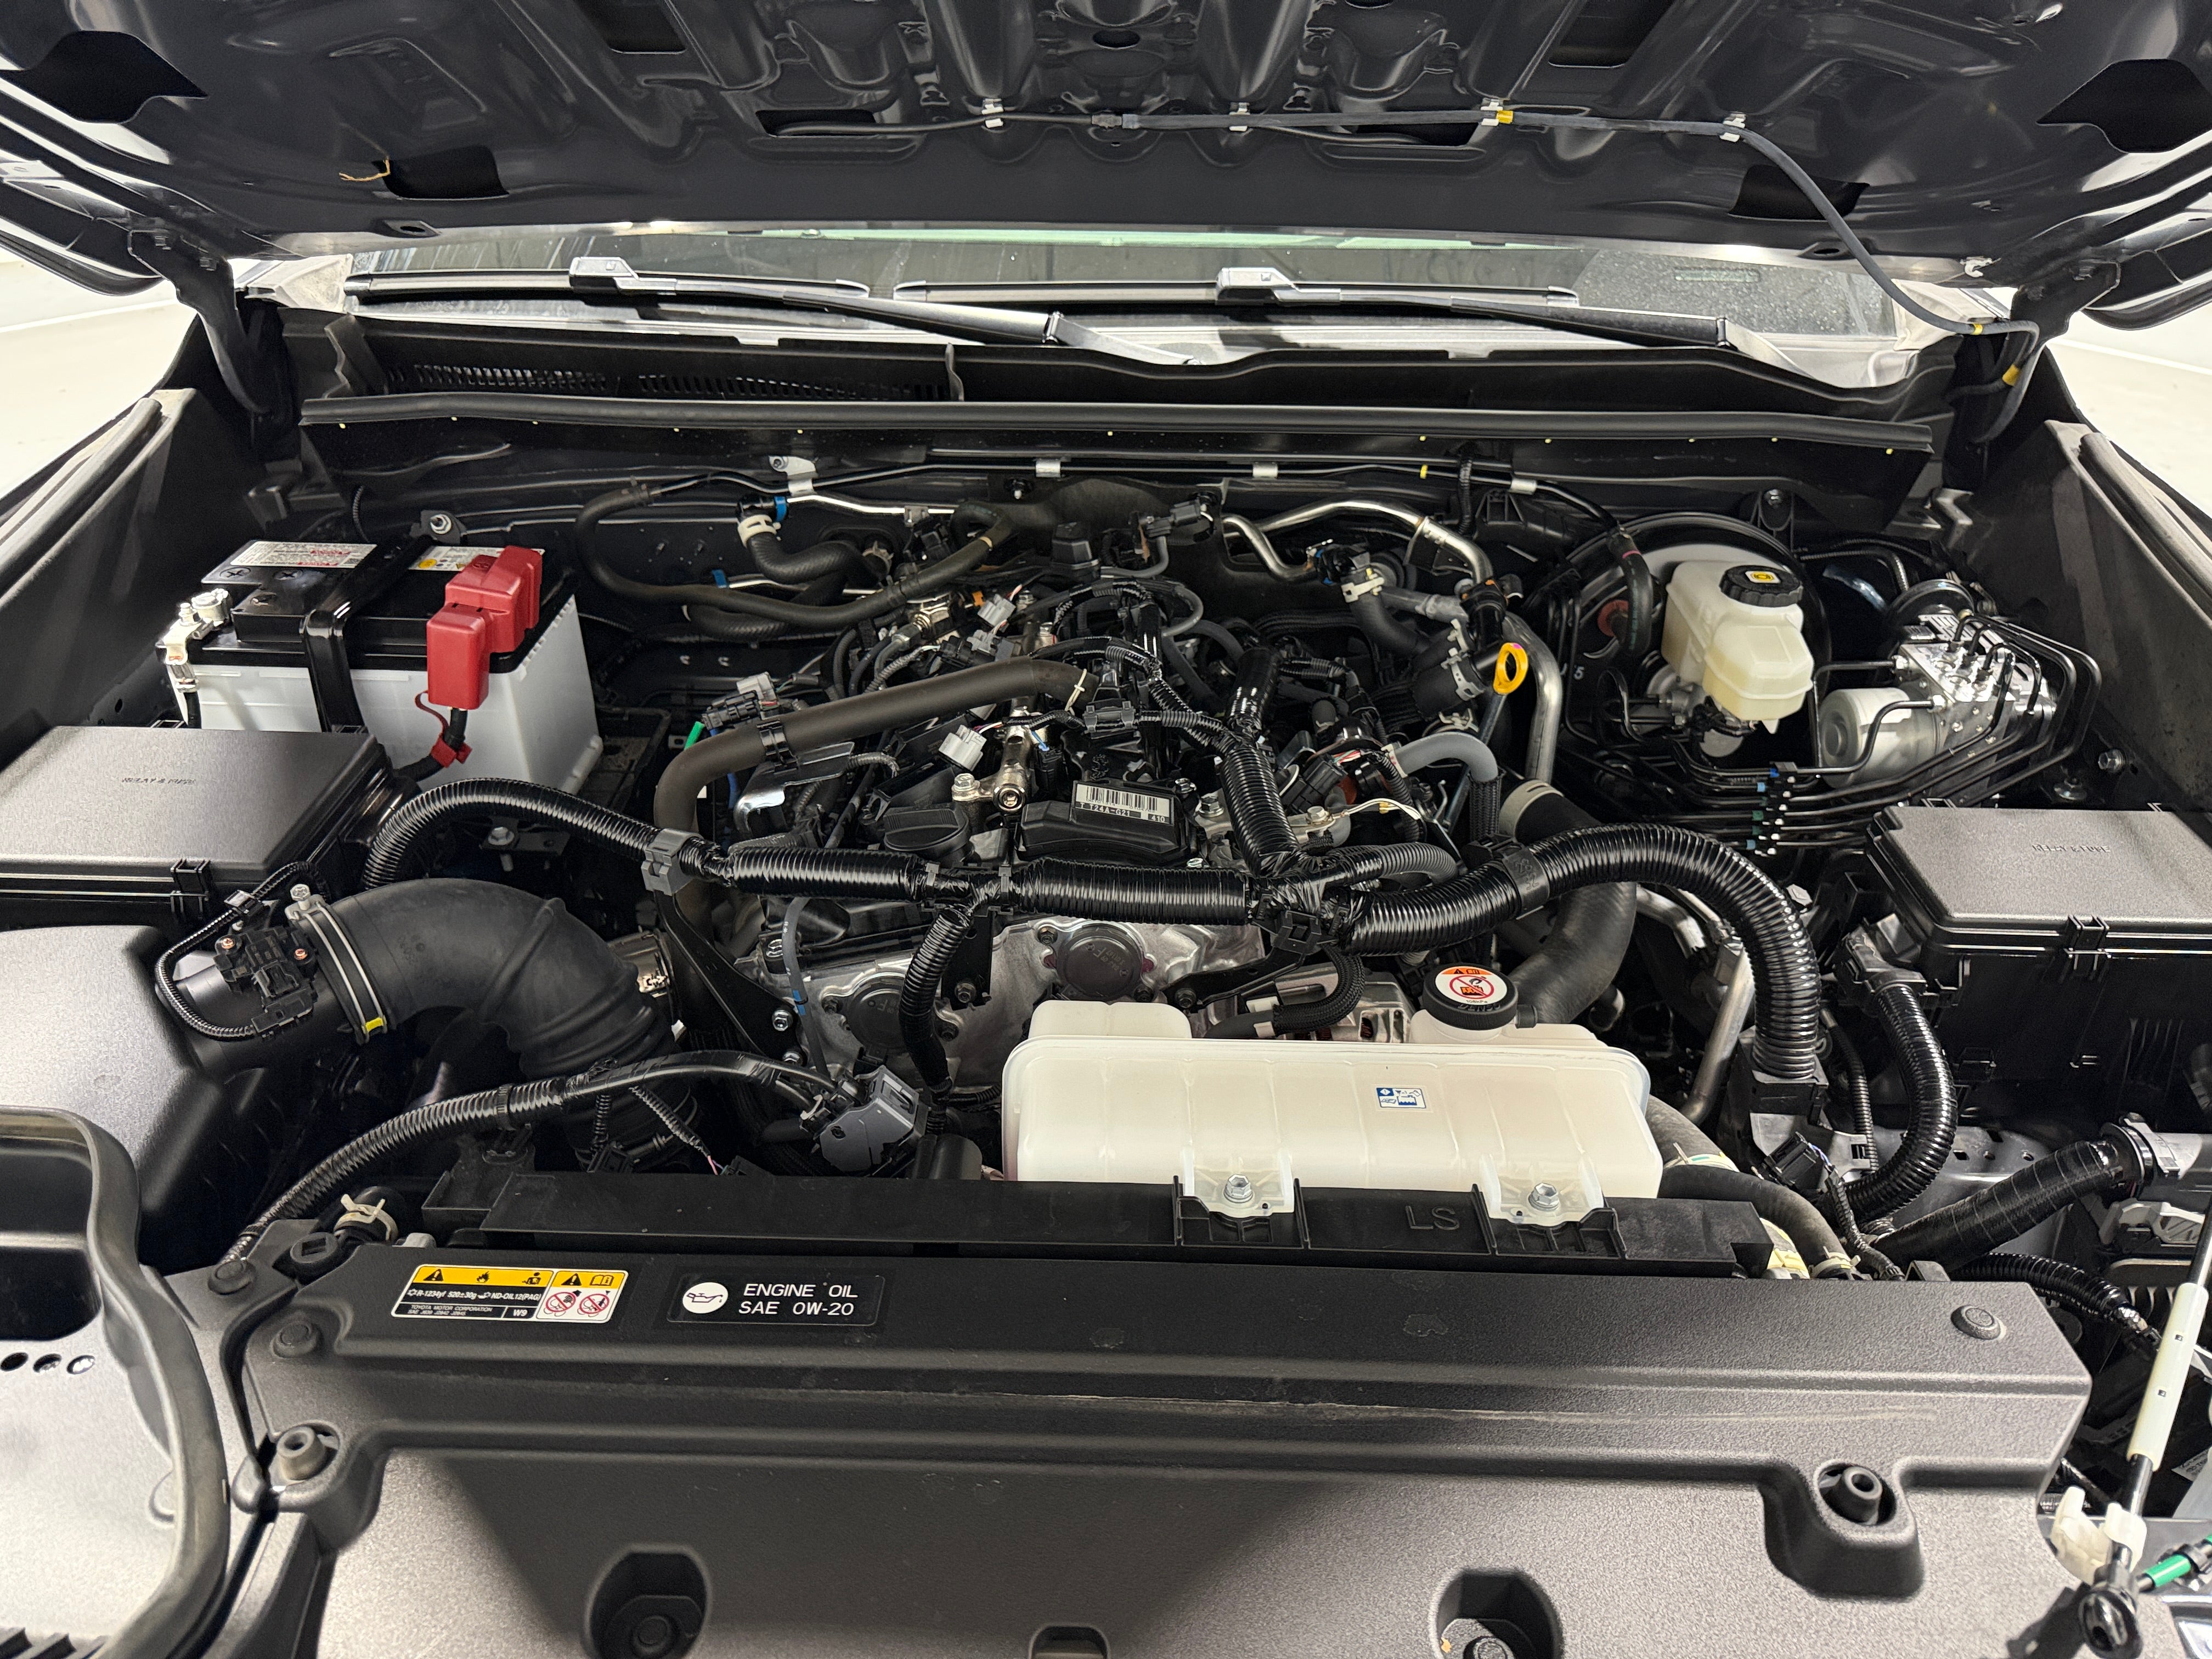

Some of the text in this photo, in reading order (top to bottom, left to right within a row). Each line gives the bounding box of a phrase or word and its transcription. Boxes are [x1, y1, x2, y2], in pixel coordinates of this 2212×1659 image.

[1090, 803, 1131, 817] T24A-G21
[1405, 1205, 1460, 1231] LS
[416, 1290, 447, 1299] R-1234yf
[447, 1291, 478, 1300] 520±30g
[743, 1283, 859, 1299] ENGINE OIL
[738, 1301, 854, 1316] SAE 0W-20
